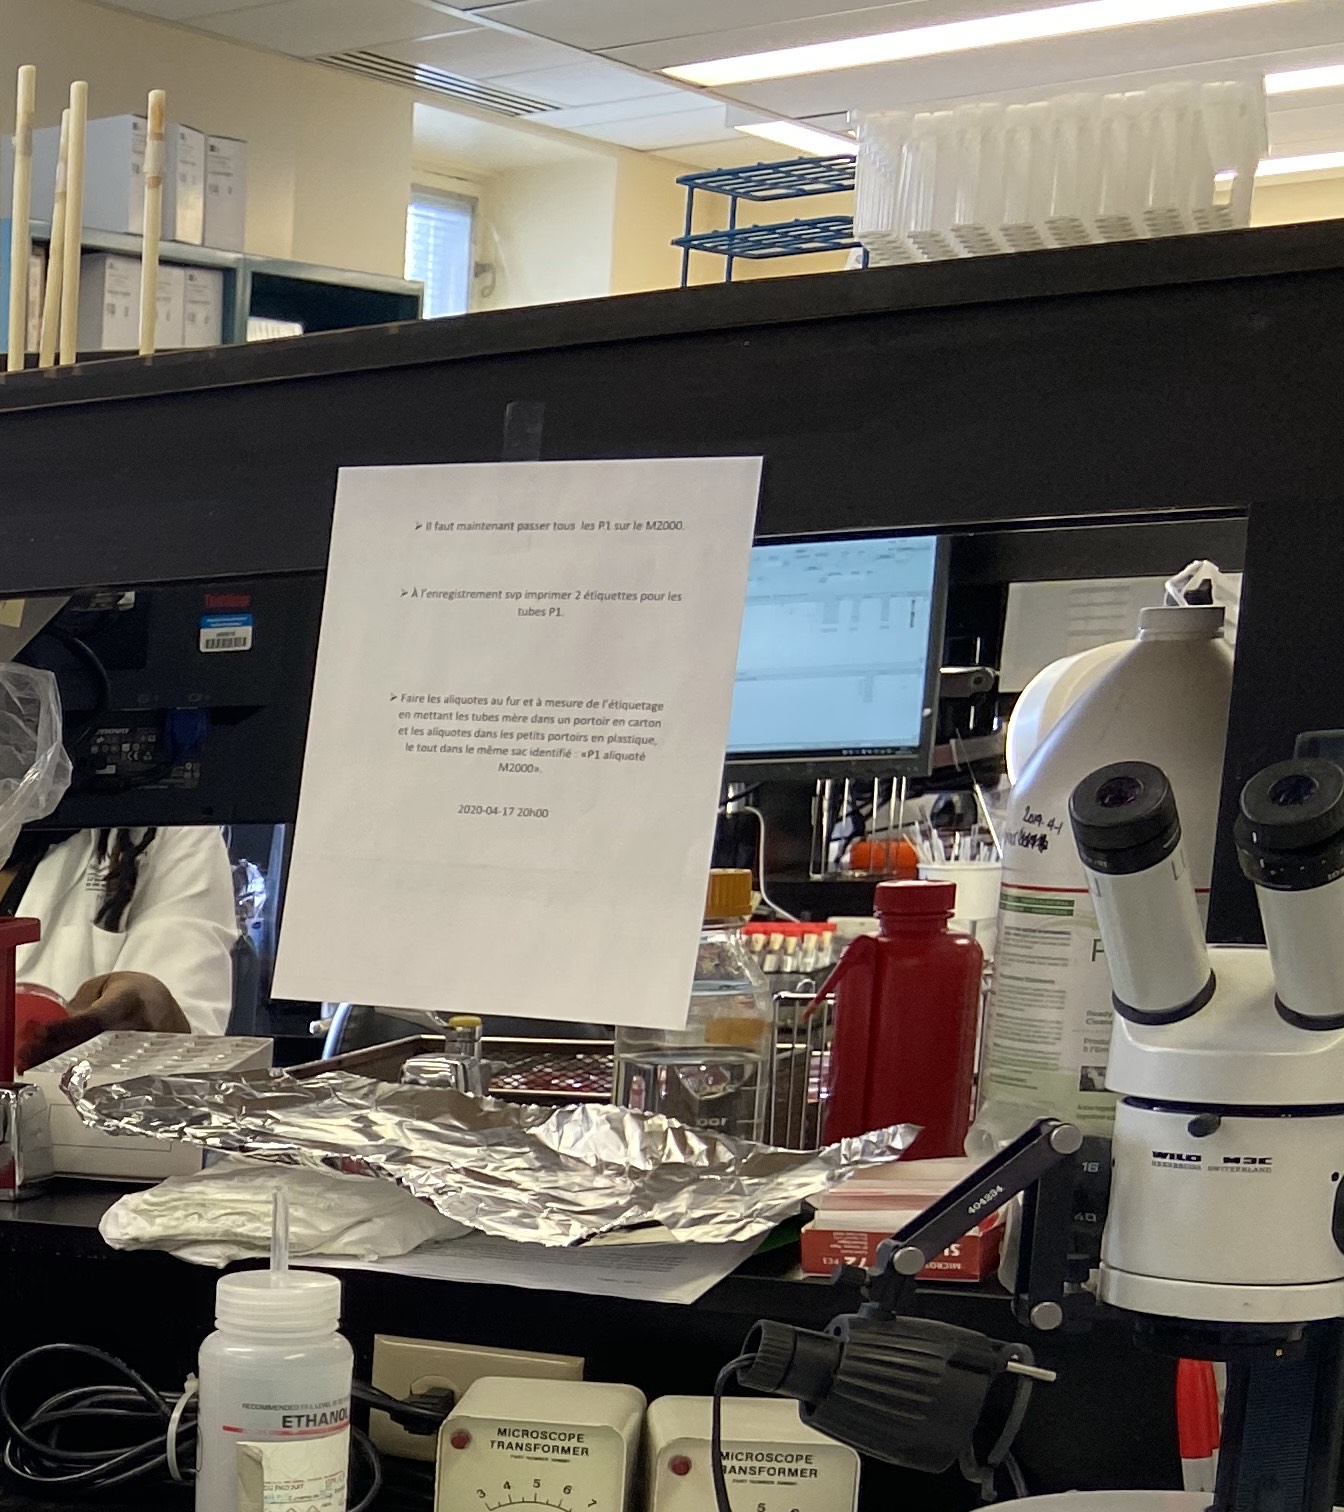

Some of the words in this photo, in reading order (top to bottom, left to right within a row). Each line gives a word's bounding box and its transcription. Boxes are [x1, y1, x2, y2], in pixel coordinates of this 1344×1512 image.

[434, 521, 455, 531] faut
[456, 521, 515, 531] maintenant
[517, 523, 551, 533] passer
[553, 521, 576, 531] tous
[580, 521, 595, 531] les
[598, 520, 610, 531] P1
[614, 523, 631, 531] sur
[633, 520, 643, 531] le
[645, 520, 685, 531] M2000.
[505, 592, 522, 601] svp
[524, 590, 572, 601] imprimer
[575, 590, 581, 600] 2
[583, 590, 638, 602] étiquettes
[640, 593, 666, 603] pour
[667, 591, 682, 601] les
[518, 607, 546, 617] tubes
[401, 693, 425, 703] Faire
[427, 694, 441, 704] les
[443, 695, 488, 706] aliquotes
[491, 698, 503, 706] au
[506, 696, 521, 706] fur
[523, 698, 534, 707] et
[536, 697, 542, 707] à
[545, 699, 584, 708] mesure
[585, 699, 600, 709] de
[405, 742, 414, 752] le
[416, 744, 438, 753] tout
[440, 744, 463, 754] dans
[465, 744, 476, 755] le
[477, 745, 510, 756] même
[511, 748, 528, 756] sac
[529, 747, 572, 759] identifié
[603, 750, 646, 762] aliquoté
[457, 804, 515, 816] 2020-04-17
[517, 807, 549, 818] 20h00
[282, 1407, 349, 1429] ETHANOL
[497, 1427, 585, 1444] MICROSCOPE
[489, 1440, 590, 1457] TRANSFORMER
[720, 1451, 814, 1465] MICROSCOPE
[476, 1488, 486, 1499] 3
[502, 1480, 512, 1490] 4
[532, 1478, 541, 1489] 5
[562, 1485, 573, 1495] 6
[587, 1498, 598, 1509] 7
[756, 1502, 767, 1512] 5
